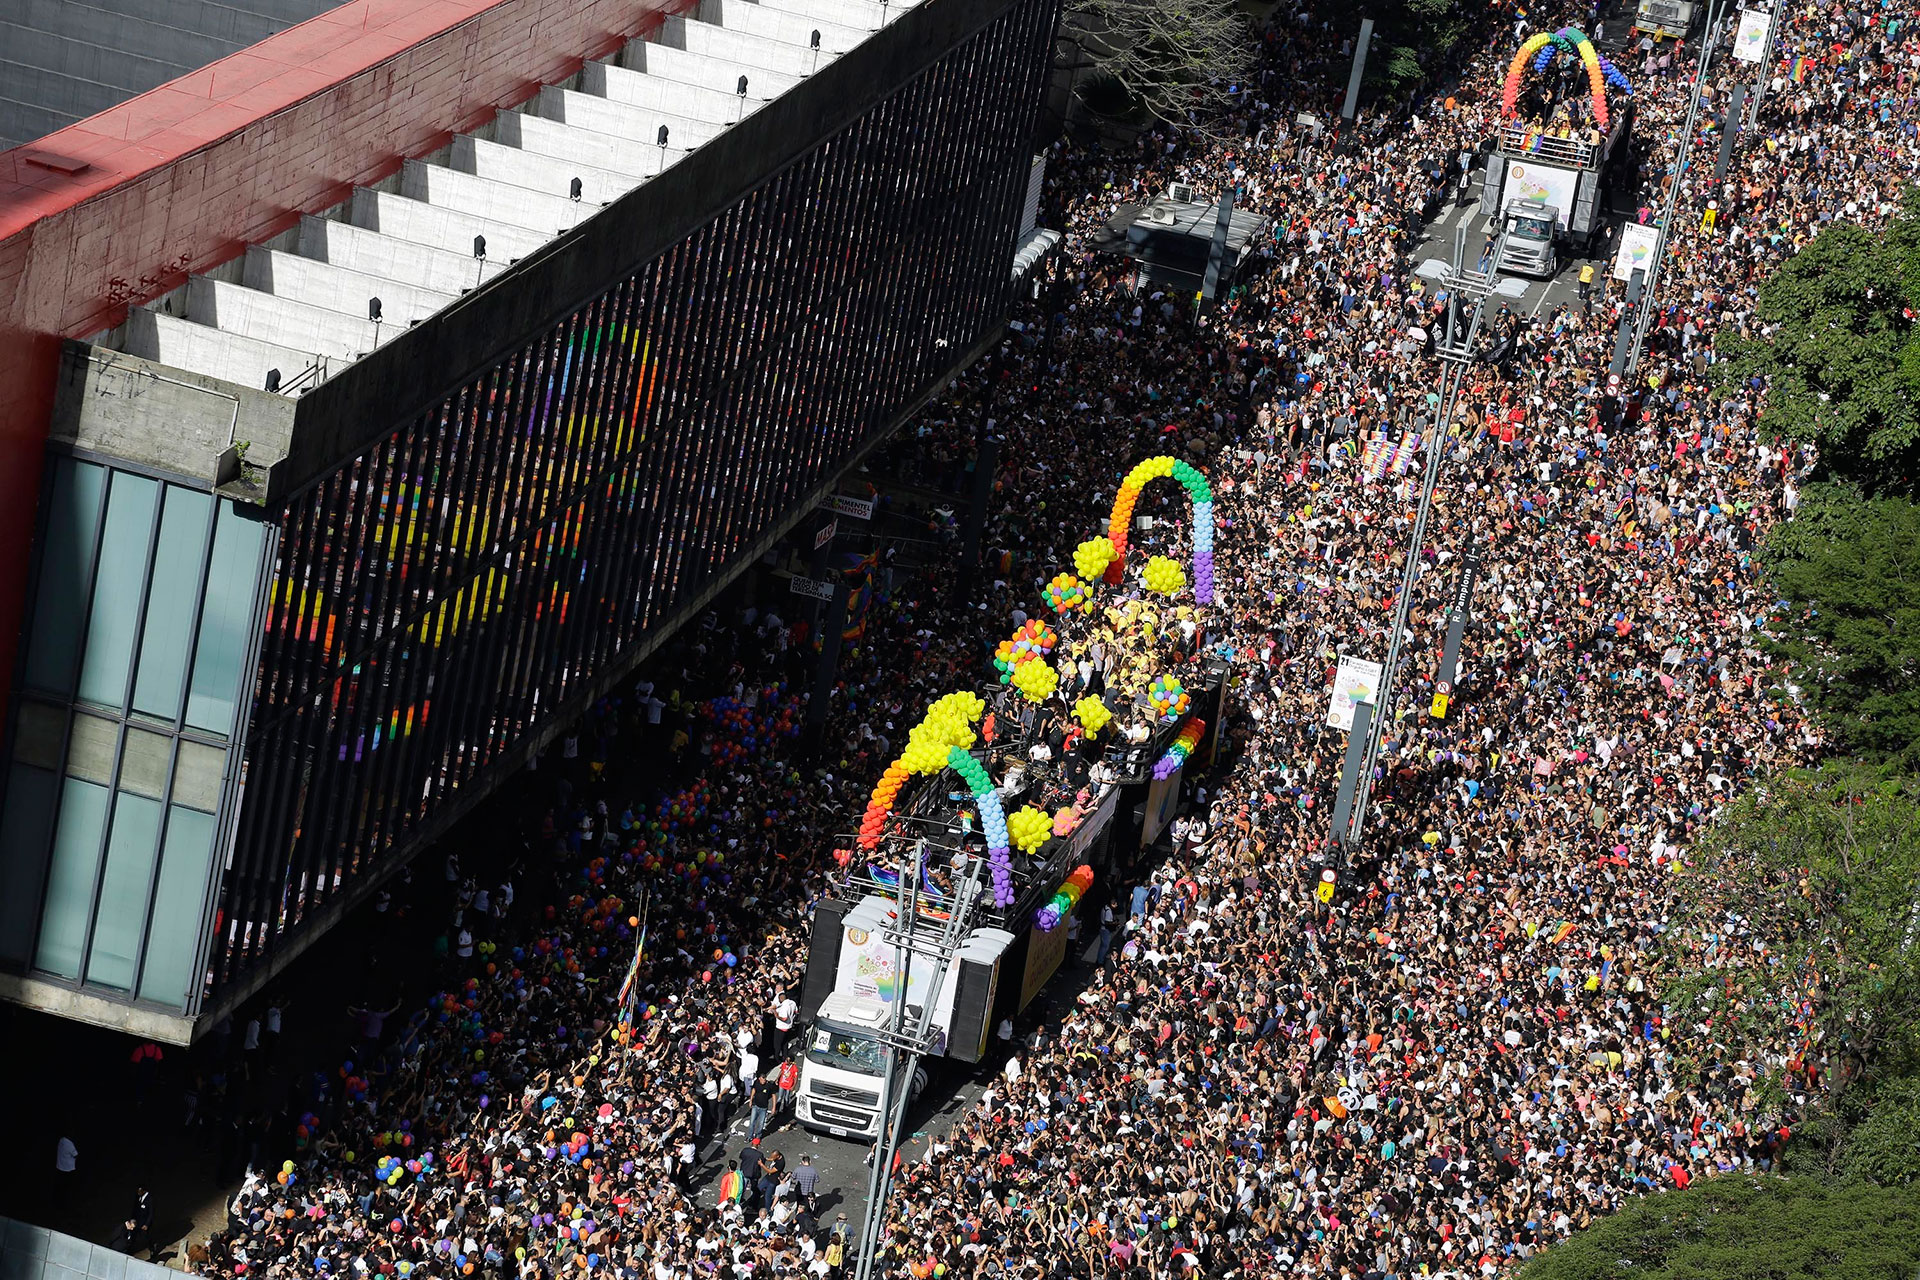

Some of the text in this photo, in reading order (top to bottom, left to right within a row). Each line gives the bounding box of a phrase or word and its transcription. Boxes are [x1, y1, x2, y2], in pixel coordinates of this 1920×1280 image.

[1455, 568, 1472, 613] Pamplona
[1452, 614, 1461, 622] R.
[1340, 657, 1349, 667] 21
